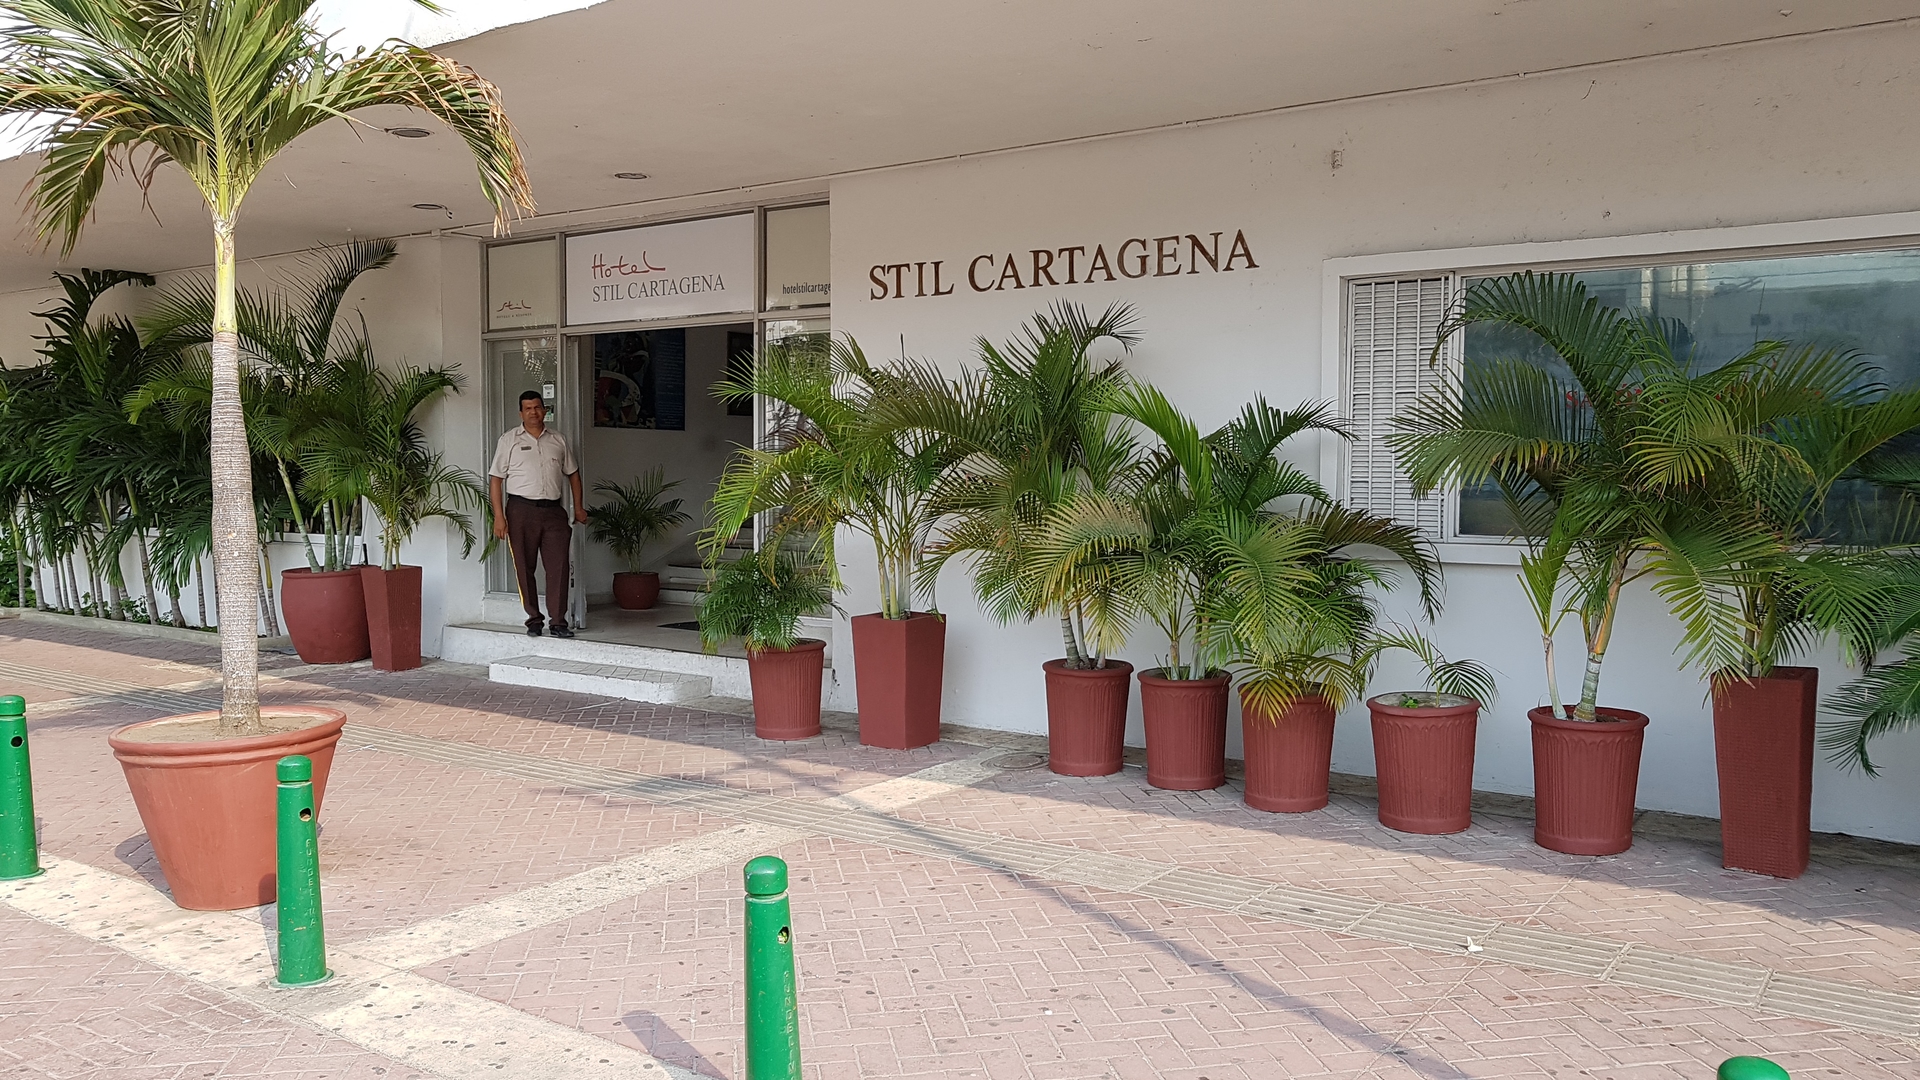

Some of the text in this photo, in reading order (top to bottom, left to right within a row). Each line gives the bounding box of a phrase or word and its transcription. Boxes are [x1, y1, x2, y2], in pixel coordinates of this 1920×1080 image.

[591, 250, 666, 279] Hotel
[592, 274, 726, 302] STIL CARTAGENA
[868, 229, 1260, 301] STIL CARTAGENA
[783, 970, 797, 1080] FUNDELIM
